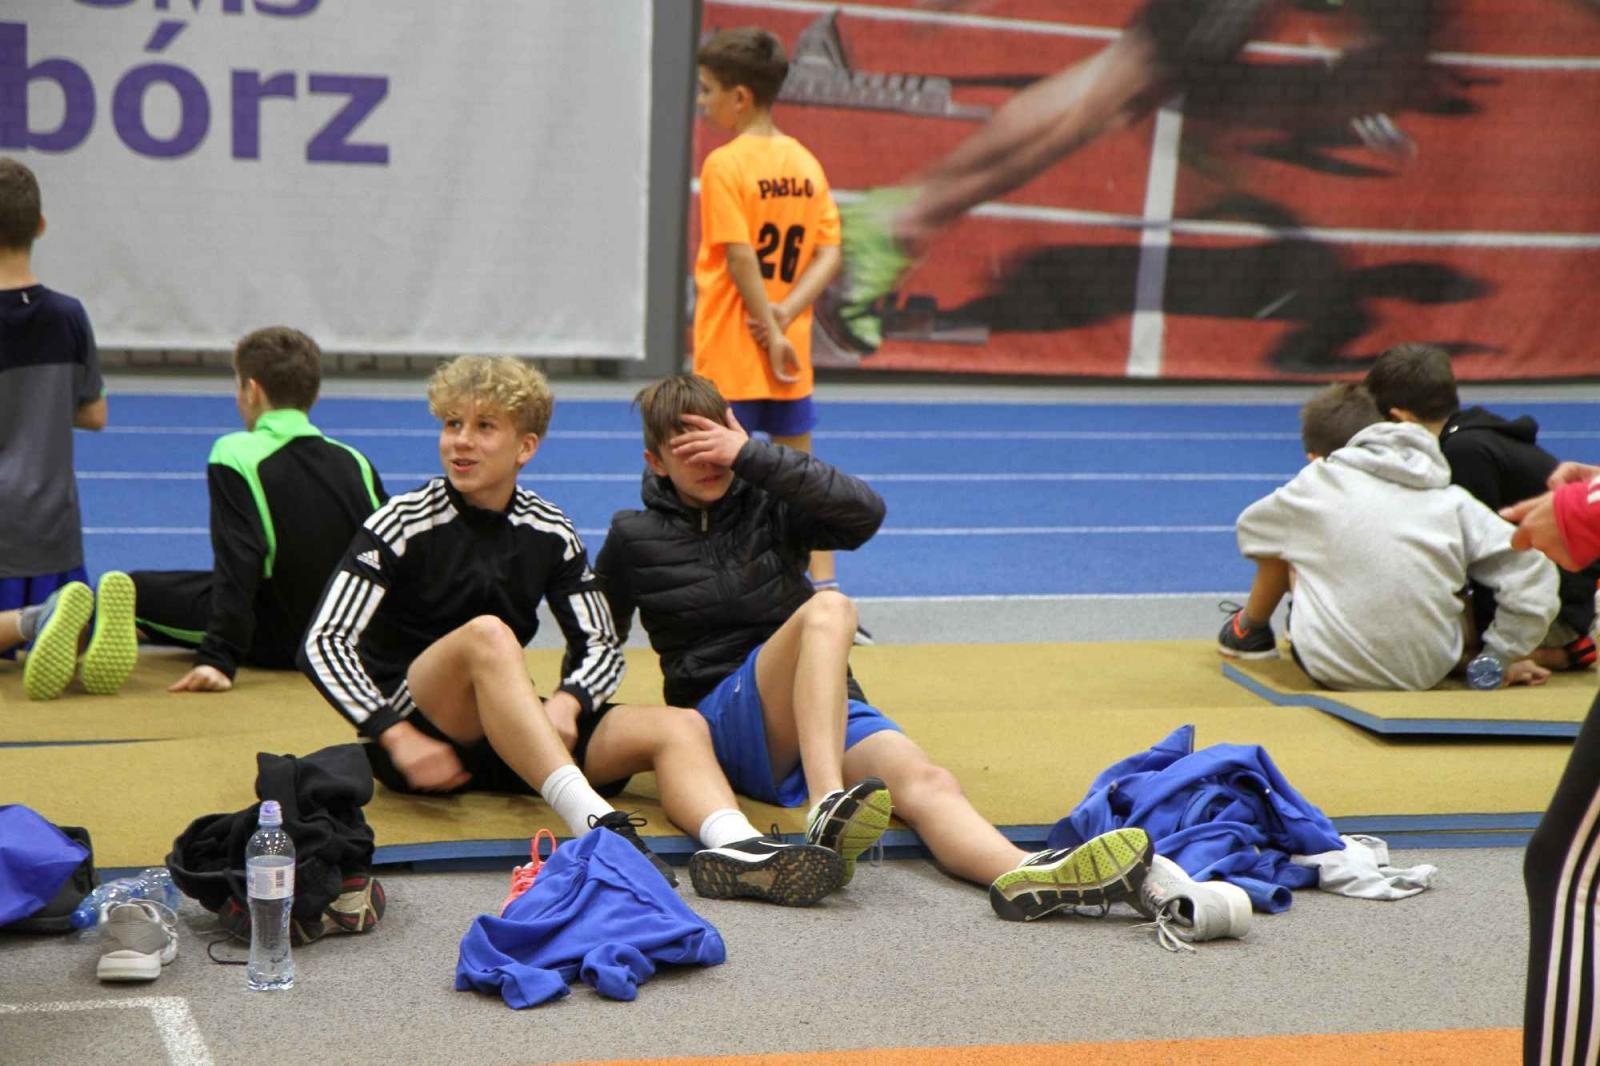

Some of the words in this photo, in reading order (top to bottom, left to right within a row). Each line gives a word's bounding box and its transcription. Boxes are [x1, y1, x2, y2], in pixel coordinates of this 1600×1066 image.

[0, 21, 390, 165] bórz
[758, 177, 814, 199] PABLO
[757, 221, 805, 283] 26
